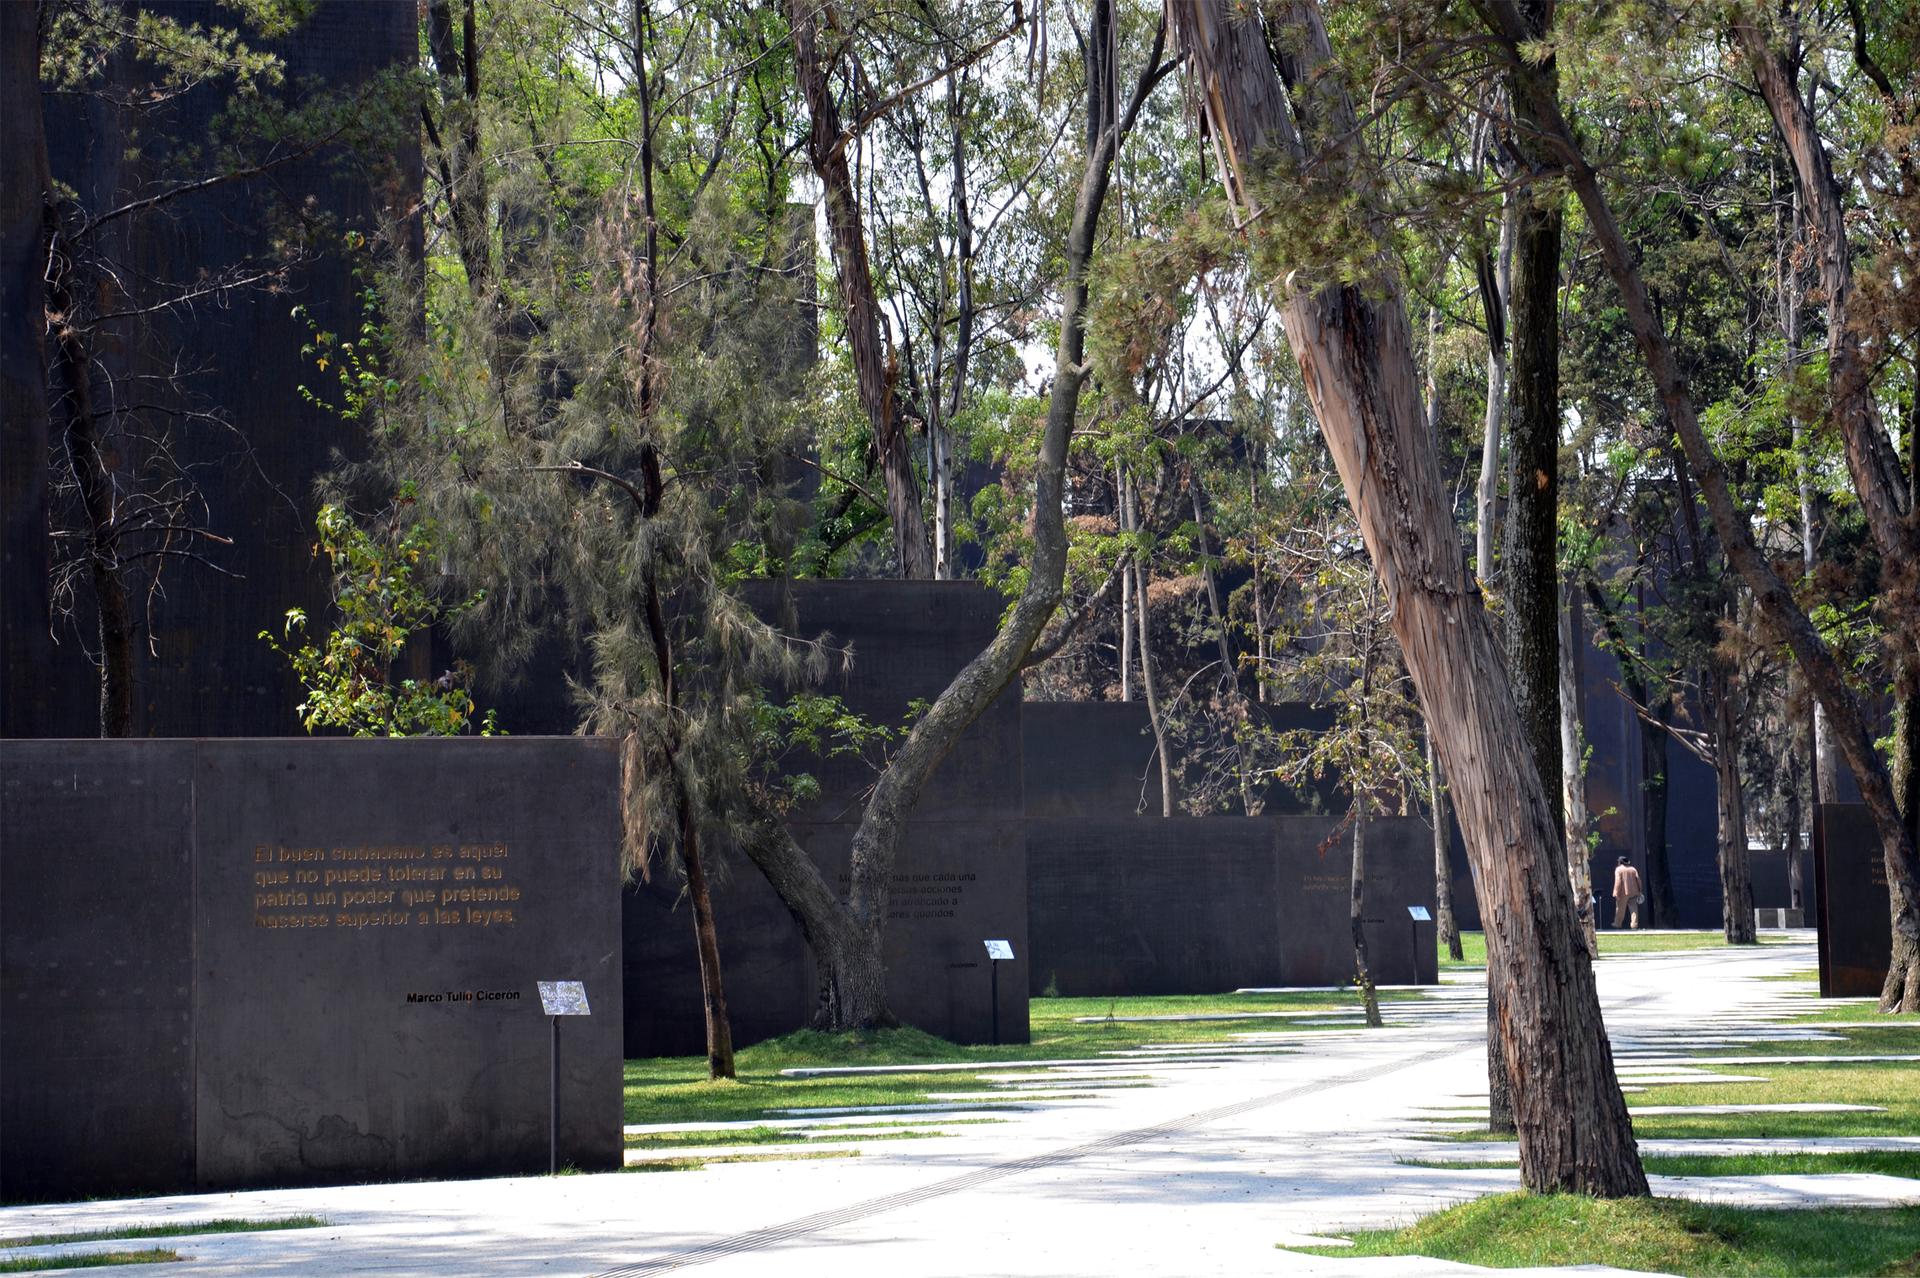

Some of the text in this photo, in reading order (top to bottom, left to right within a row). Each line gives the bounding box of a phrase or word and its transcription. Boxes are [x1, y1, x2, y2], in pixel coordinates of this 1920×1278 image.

[255, 844, 273, 862] El
[279, 844, 325, 862] buen
[331, 841, 425, 861] ciudadano
[432, 843, 454, 859] es
[255, 863, 503, 887] que no puede tolerar en su
[933, 872, 956, 882] cada
[958, 873, 976, 882] una
[255, 885, 521, 909] patria un poder que pretende
[920, 885, 962, 895] acciones
[255, 911, 329, 928] hacerse
[336, 908, 410, 930] superior
[416, 911, 429, 925] a
[435, 907, 461, 924] las
[406, 989, 520, 1004] Marco Tulio Cicerón
